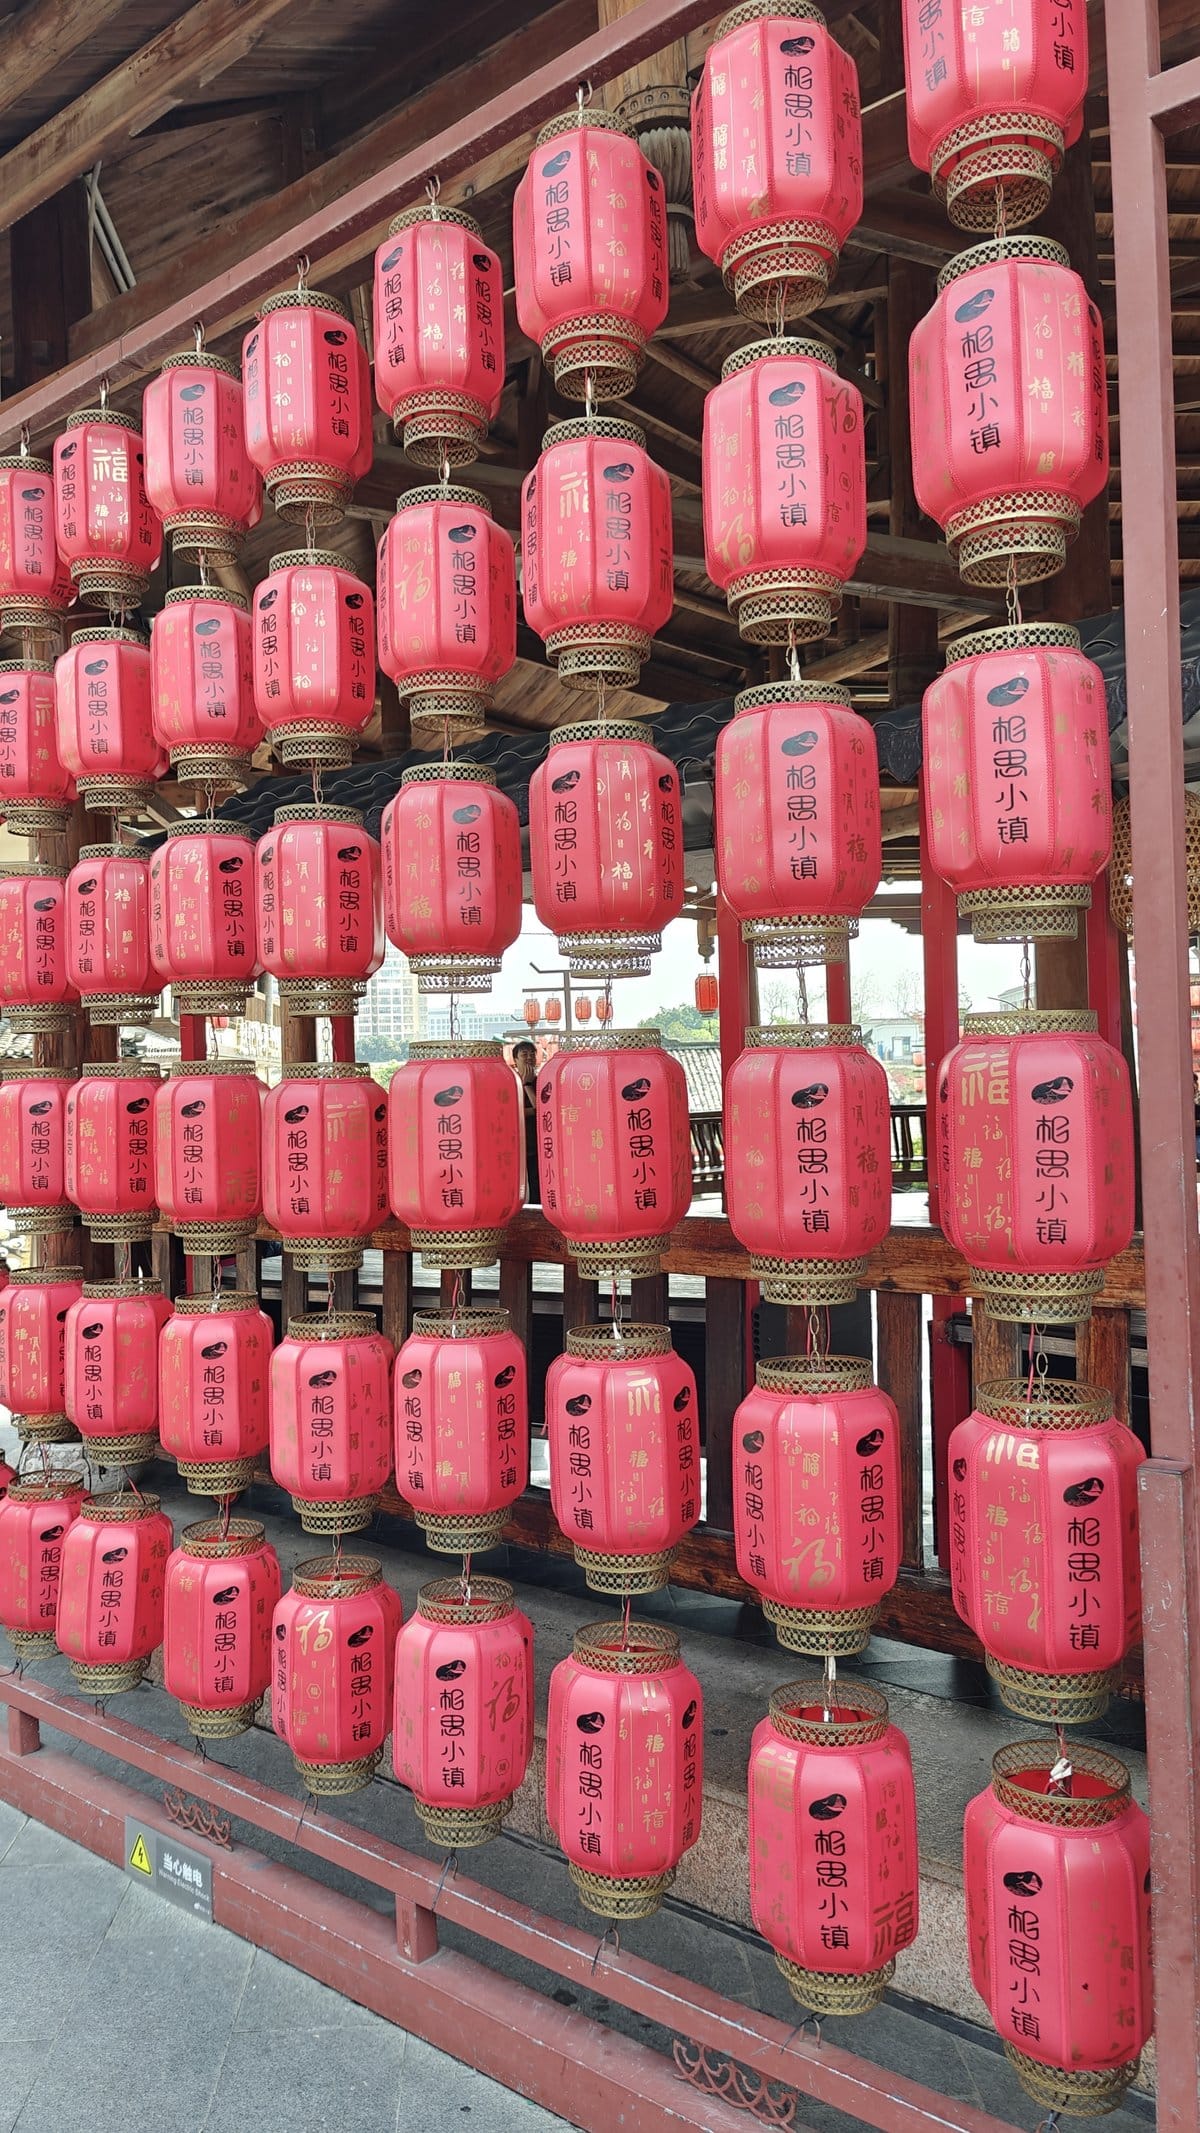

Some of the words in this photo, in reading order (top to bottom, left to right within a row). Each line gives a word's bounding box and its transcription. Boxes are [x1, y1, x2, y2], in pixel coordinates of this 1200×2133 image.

[784, 65, 812, 177] 相思小镇
[546, 181, 571, 287] 相思小镇
[384, 275, 405, 367] 相思小镇
[327, 353, 350, 436] 相思小镇
[962, 325, 1001, 453] 相思小镇
[182, 407, 204, 485] 相思小镇
[774, 415, 806, 526] 相思小镇
[24, 507, 43, 575] 相思小镇
[61, 464, 76, 538] 相思小镇
[605, 492, 631, 592] 相思小镇
[452, 551, 476, 643] 相思小镇
[200, 641, 227, 718] 相思小镇
[261, 614, 281, 698] 相思小镇
[348, 616, 366, 700] 相思小镇
[87, 681, 109, 754] 相思小镇
[787, 766, 817, 879] 相思小镇
[992, 715, 1028, 843] 相思小镇
[457, 831, 481, 925] 相思小镇
[555, 801, 577, 902] 相思小镇
[36, 917, 55, 985] 相思小镇
[80, 901, 94, 973] 相思小镇
[223, 880, 245, 956] 相思小镇
[340, 870, 360, 952] 相思小镇
[31, 1120, 49, 1189] 相思小镇
[129, 1120, 146, 1193] 相思小镇
[184, 1124, 203, 1204] 相思小镇
[288, 1129, 310, 1215] 相思小镇
[438, 1113, 463, 1208] 相思小镇
[627, 1108, 657, 1210] 相思小镇
[796, 1116, 829, 1233] 相思小镇
[1035, 1115, 1069, 1245] 相思小镇
[84, 1345, 103, 1421] 相思小镇
[203, 1366, 225, 1446] 相思小镇
[311, 1396, 334, 1481] 相思小镇
[404, 1396, 424, 1491] 相思小镇
[496, 1394, 517, 1489] 相思小镇
[568, 1425, 594, 1531] 相思小镇
[745, 1463, 768, 1580] 相思小镇
[860, 1465, 885, 1582] 相思小镇
[98, 1572, 122, 1646] 相思小镇
[1067, 1518, 1100, 1649] 相思小镇
[214, 1612, 237, 1692] 相思小镇
[350, 1652, 372, 1741] 相思小镇
[440, 1689, 465, 1788] 相思小镇
[579, 1744, 602, 1856] 相思小镇
[163, 1852, 203, 1888] 当心触电
[815, 1831, 850, 1949] 相思小镇
[1008, 1904, 1041, 2042] 相思小镇
